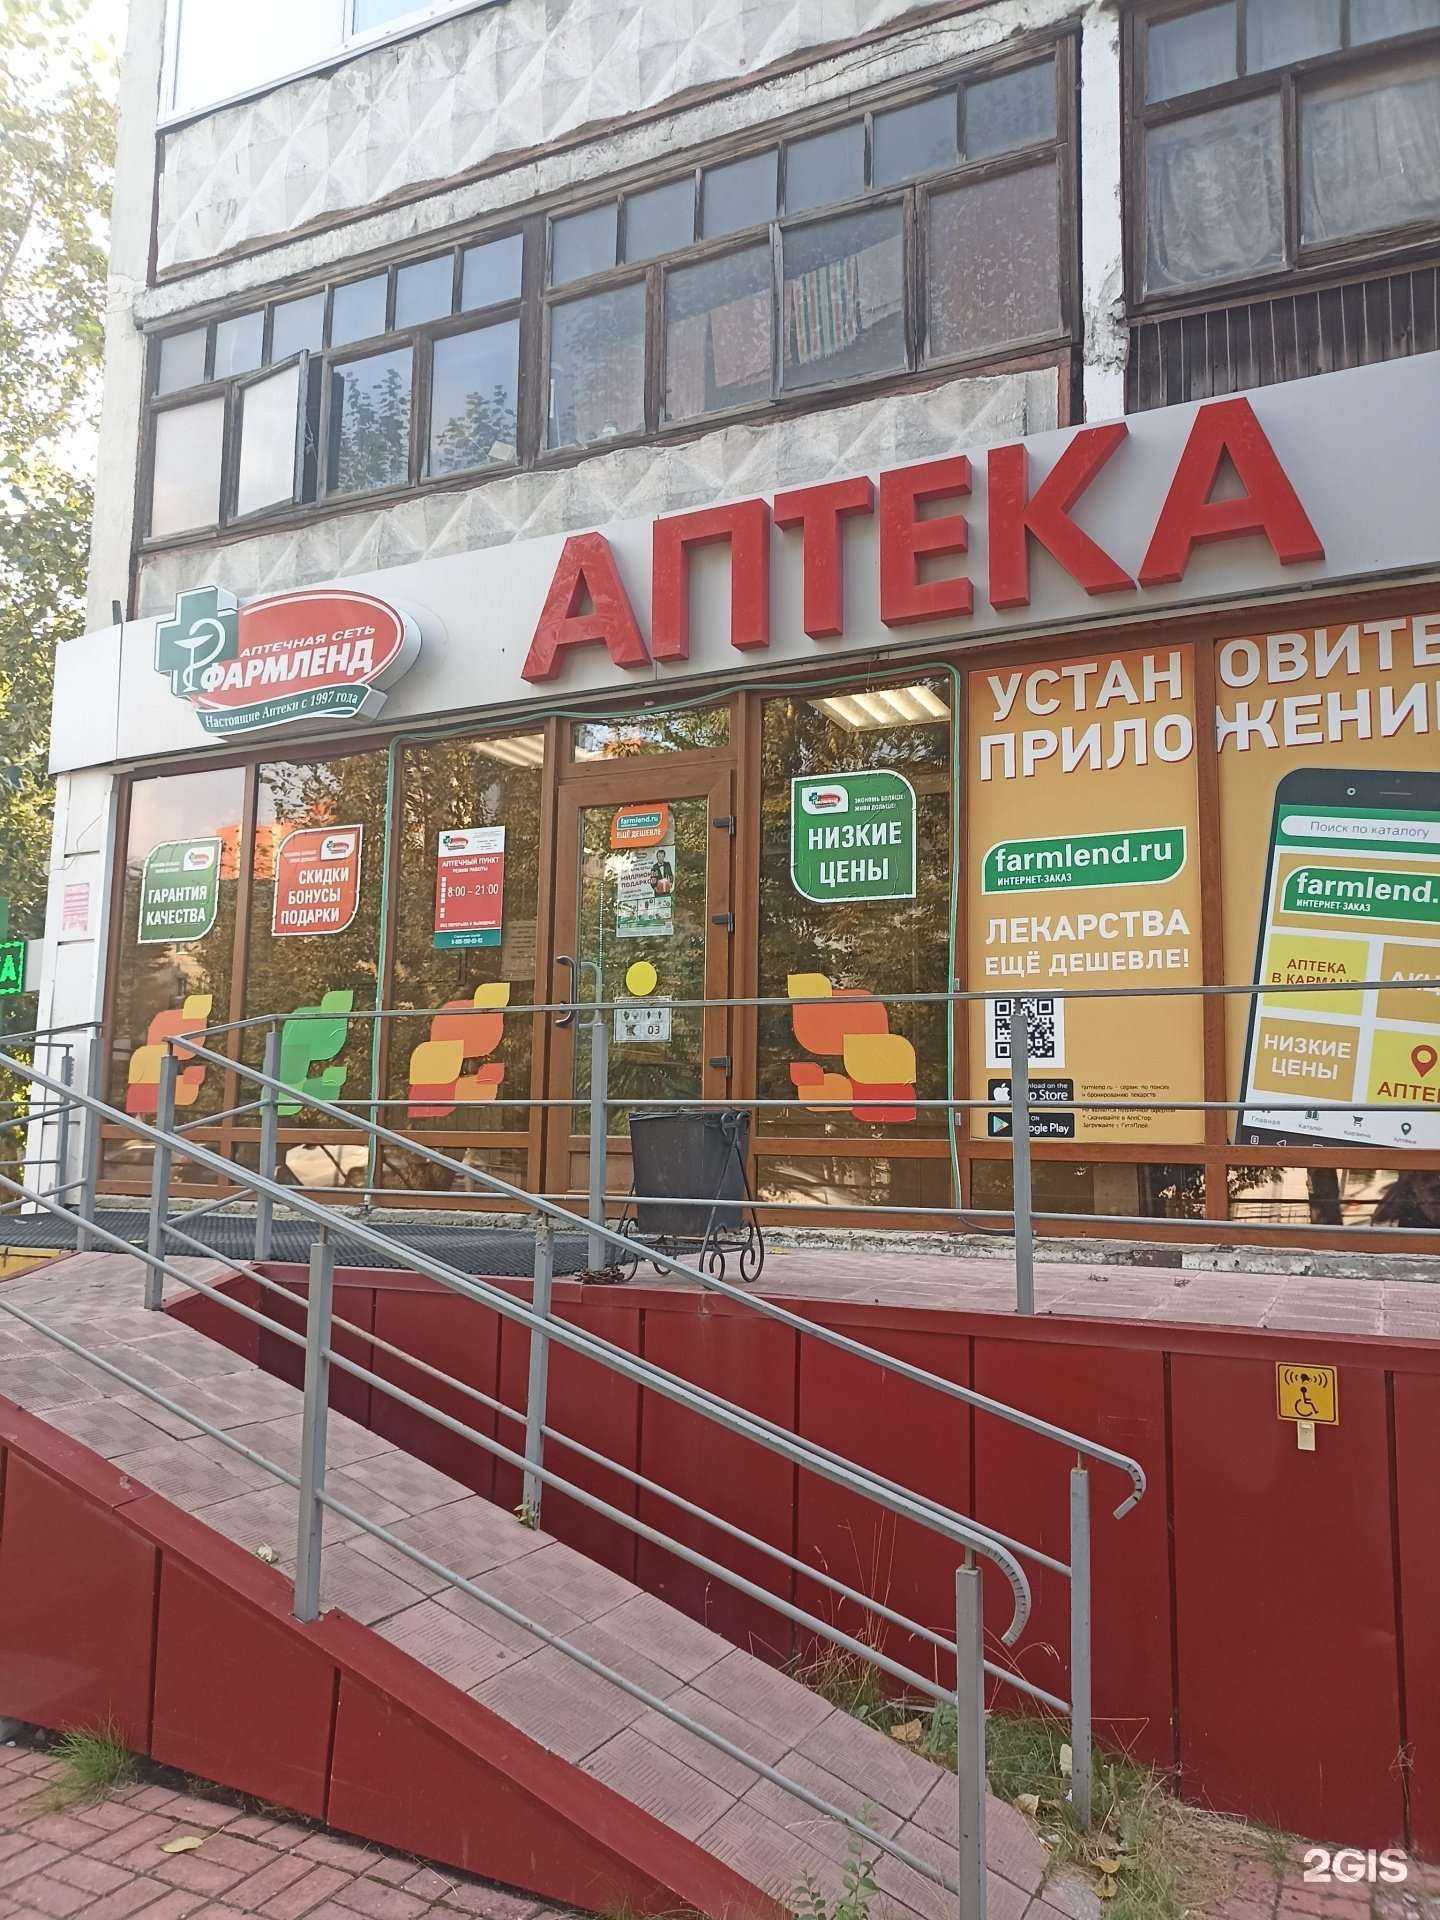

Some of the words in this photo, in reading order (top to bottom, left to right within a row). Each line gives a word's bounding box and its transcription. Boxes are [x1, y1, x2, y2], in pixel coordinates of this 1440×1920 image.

[521, 398, 1325, 684] АПТЕКА
[239, 634, 326, 657] АПТЕЧНАЯ
[332, 625, 376, 641] СЕТЬ
[1219, 614, 1440, 687] ОВИТЕ
[200, 638, 375, 692] ФАРМЛЕНД
[988, 651, 1183, 721] УСТАН
[205, 711, 260, 728] Настоящие
[262, 701, 299, 718] Аптеки
[301, 698, 307, 708] с
[310, 691, 334, 706] 1997
[336, 692, 358, 704] года
[1216, 681, 1440, 753] ЖЕНИ
[979, 714, 1194, 781] ПРИЛО
[808, 821, 901, 850] НИЗКИЕ
[1310, 821, 1348, 833] Поиск
[1352, 825, 1368, 834] по
[1372, 827, 1430, 839] каталогу
[995, 839, 1172, 872] farmlend.ru
[298, 867, 349, 885] СКИДКИ
[820, 858, 889, 888] ЦЕНЫ
[997, 873, 1072, 886] ИНТЕРНЕТ-ЗАКАЗ
[148, 885, 207, 904] ГАРАНТИЯ
[288, 888, 341, 905] БОНУСЫ
[447, 886, 465, 897] 8:00
[475, 884, 498, 895] 21:00
[146, 908, 206, 926] КАЧЕСТВА
[280, 907, 340, 927] ПОДАРКИ
[1296, 899, 1371, 912] ИНТЕРНЕТ-ЗАКАЗ
[985, 909, 1190, 944] ЛЕКАРСТВА
[985, 951, 1041, 977] ЕЩЁ
[1048, 949, 1190, 977] ДЕШЕВЛЕ!
[1287, 959, 1346, 974] АПТЕКА
[1272, 972, 1282, 983] В
[1264, 1033, 1353, 1059] НИЗКИЕ
[1271, 1057, 1339, 1080] ЦЕНЫ
[1039, 1089, 1068, 1100] Store
[1377, 1082, 1440, 1103] АПТЕ
[1050, 1123, 1069, 1134] Play
